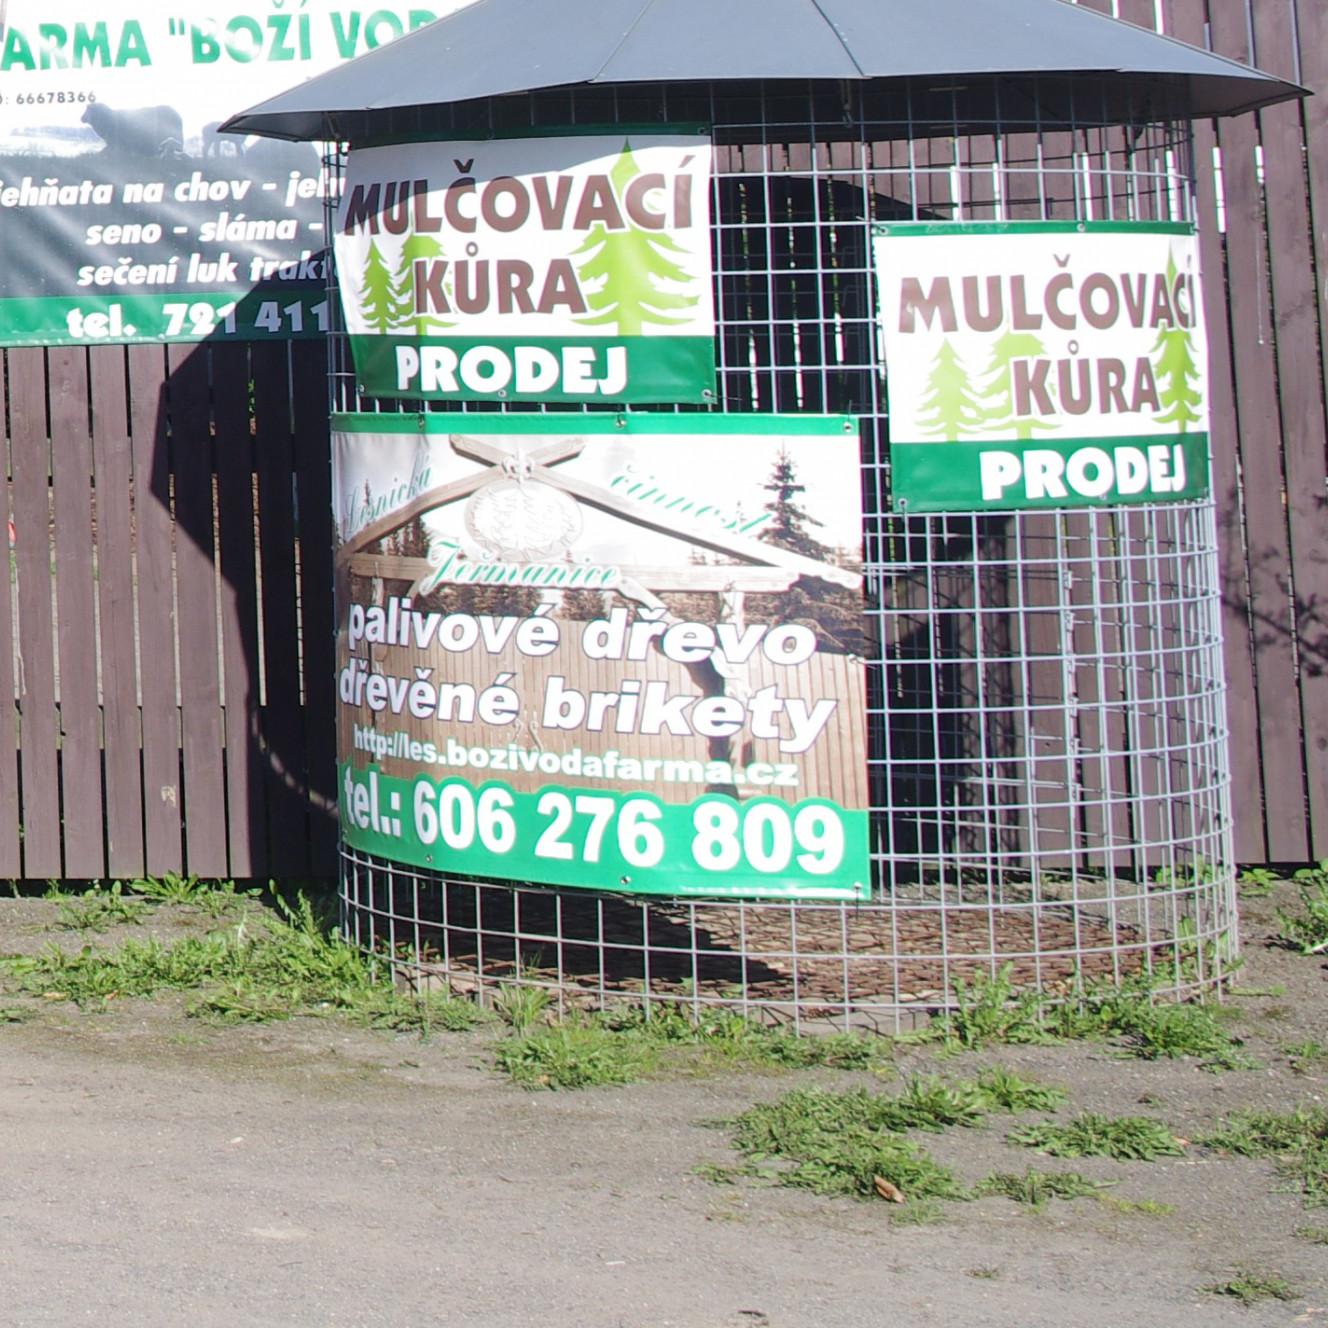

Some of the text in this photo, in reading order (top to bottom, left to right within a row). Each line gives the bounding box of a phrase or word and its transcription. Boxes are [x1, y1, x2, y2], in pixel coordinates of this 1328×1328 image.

[16, 91, 97, 105] 66678366
[123, 183, 164, 204] na
[174, 172, 251, 202] chov
[344, 155, 695, 235] MULČOVACÍ
[85, 223, 162, 245] seno
[199, 212, 297, 242] sláma
[77, 256, 180, 287] sečení
[187, 252, 238, 282] luk
[414, 241, 589, 315] KŮRA
[898, 253, 1197, 334] MULČOVACÍ
[66, 304, 137, 339] tel.
[162, 302, 237, 336] 721
[395, 345, 628, 395] PRODEJ
[1013, 339, 1161, 416] KŮRA
[979, 444, 1186, 501] PRODEJ
[348, 597, 819, 666] palivové dřevo
[339, 656, 838, 754] dřevěné brikety
[353, 722, 800, 787] http://les.bozivodafarma.cz
[344, 765, 845, 875] tel.: 606 276 809
